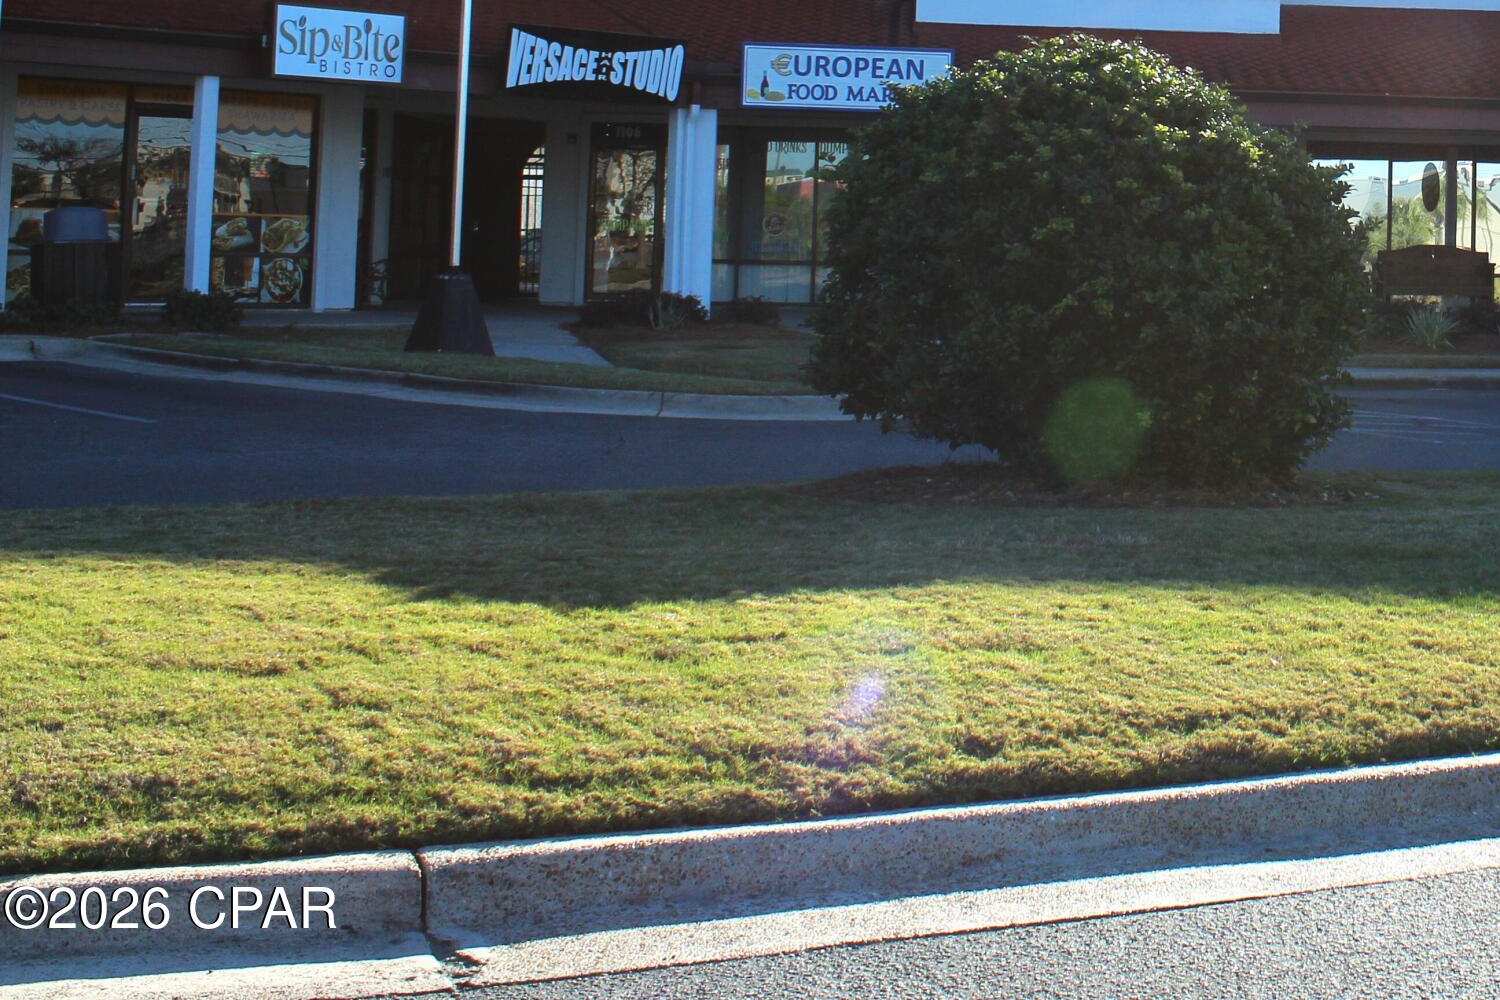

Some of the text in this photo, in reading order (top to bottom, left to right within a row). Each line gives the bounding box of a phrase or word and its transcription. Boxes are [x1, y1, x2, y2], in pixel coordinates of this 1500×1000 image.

[320, 60, 396, 78] BISTRO
[506, 27, 685, 102] VERSACE HAIR STUDIO
[787, 84, 895, 103] FOOD MAR
